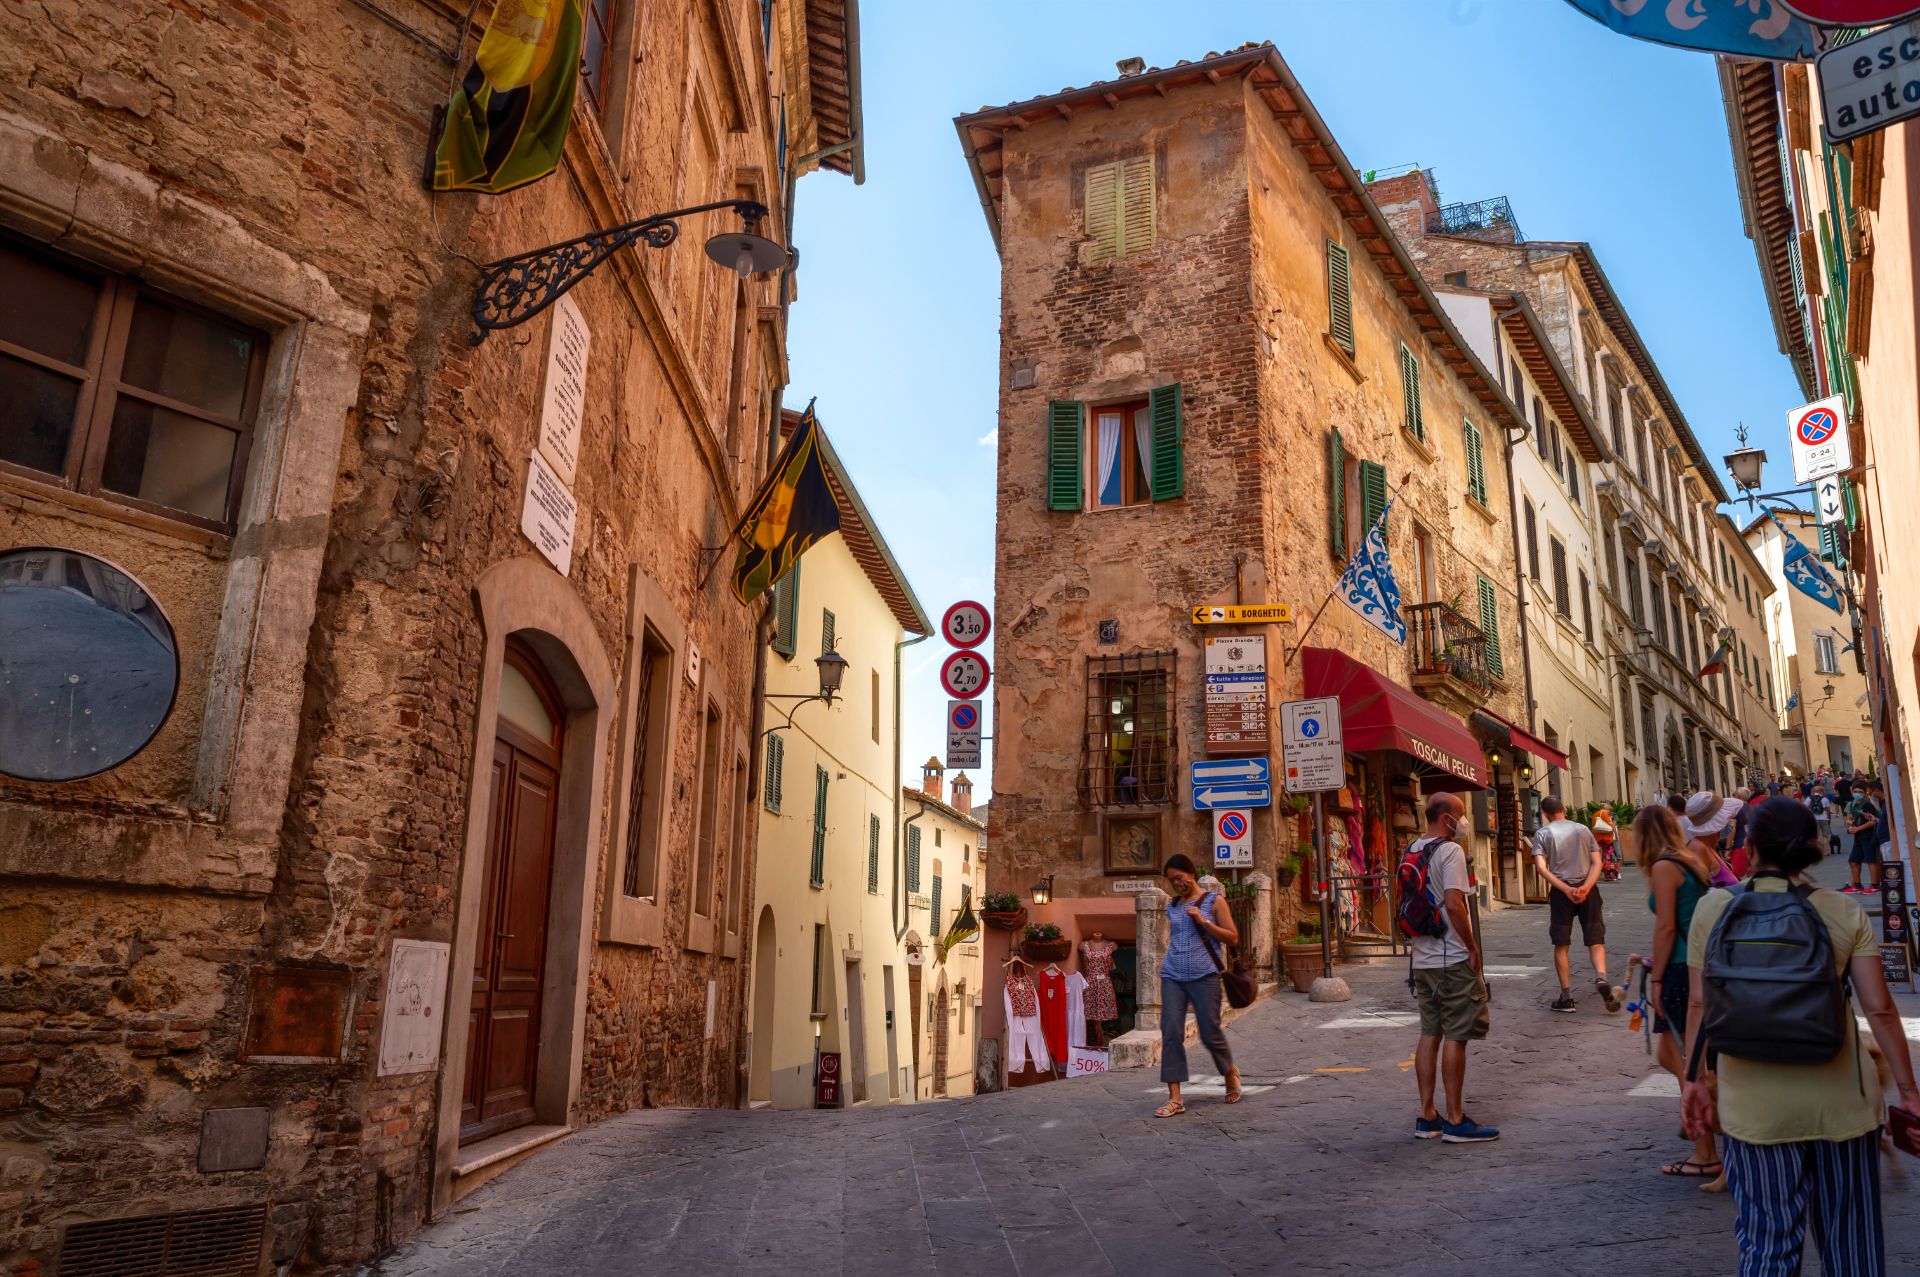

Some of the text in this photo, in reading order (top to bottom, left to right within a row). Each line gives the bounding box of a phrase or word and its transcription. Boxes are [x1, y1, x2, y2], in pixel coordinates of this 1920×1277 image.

[1837, 80, 1920, 128] auto
[1229, 608, 1286, 618] IL BORGHETTO
[953, 615, 981, 635] 3.50
[953, 665, 977, 685] 2.70
[1411, 738, 1478, 782] TOSCAN PELLE
[1070, 1057, 1105, 1073] -50%
